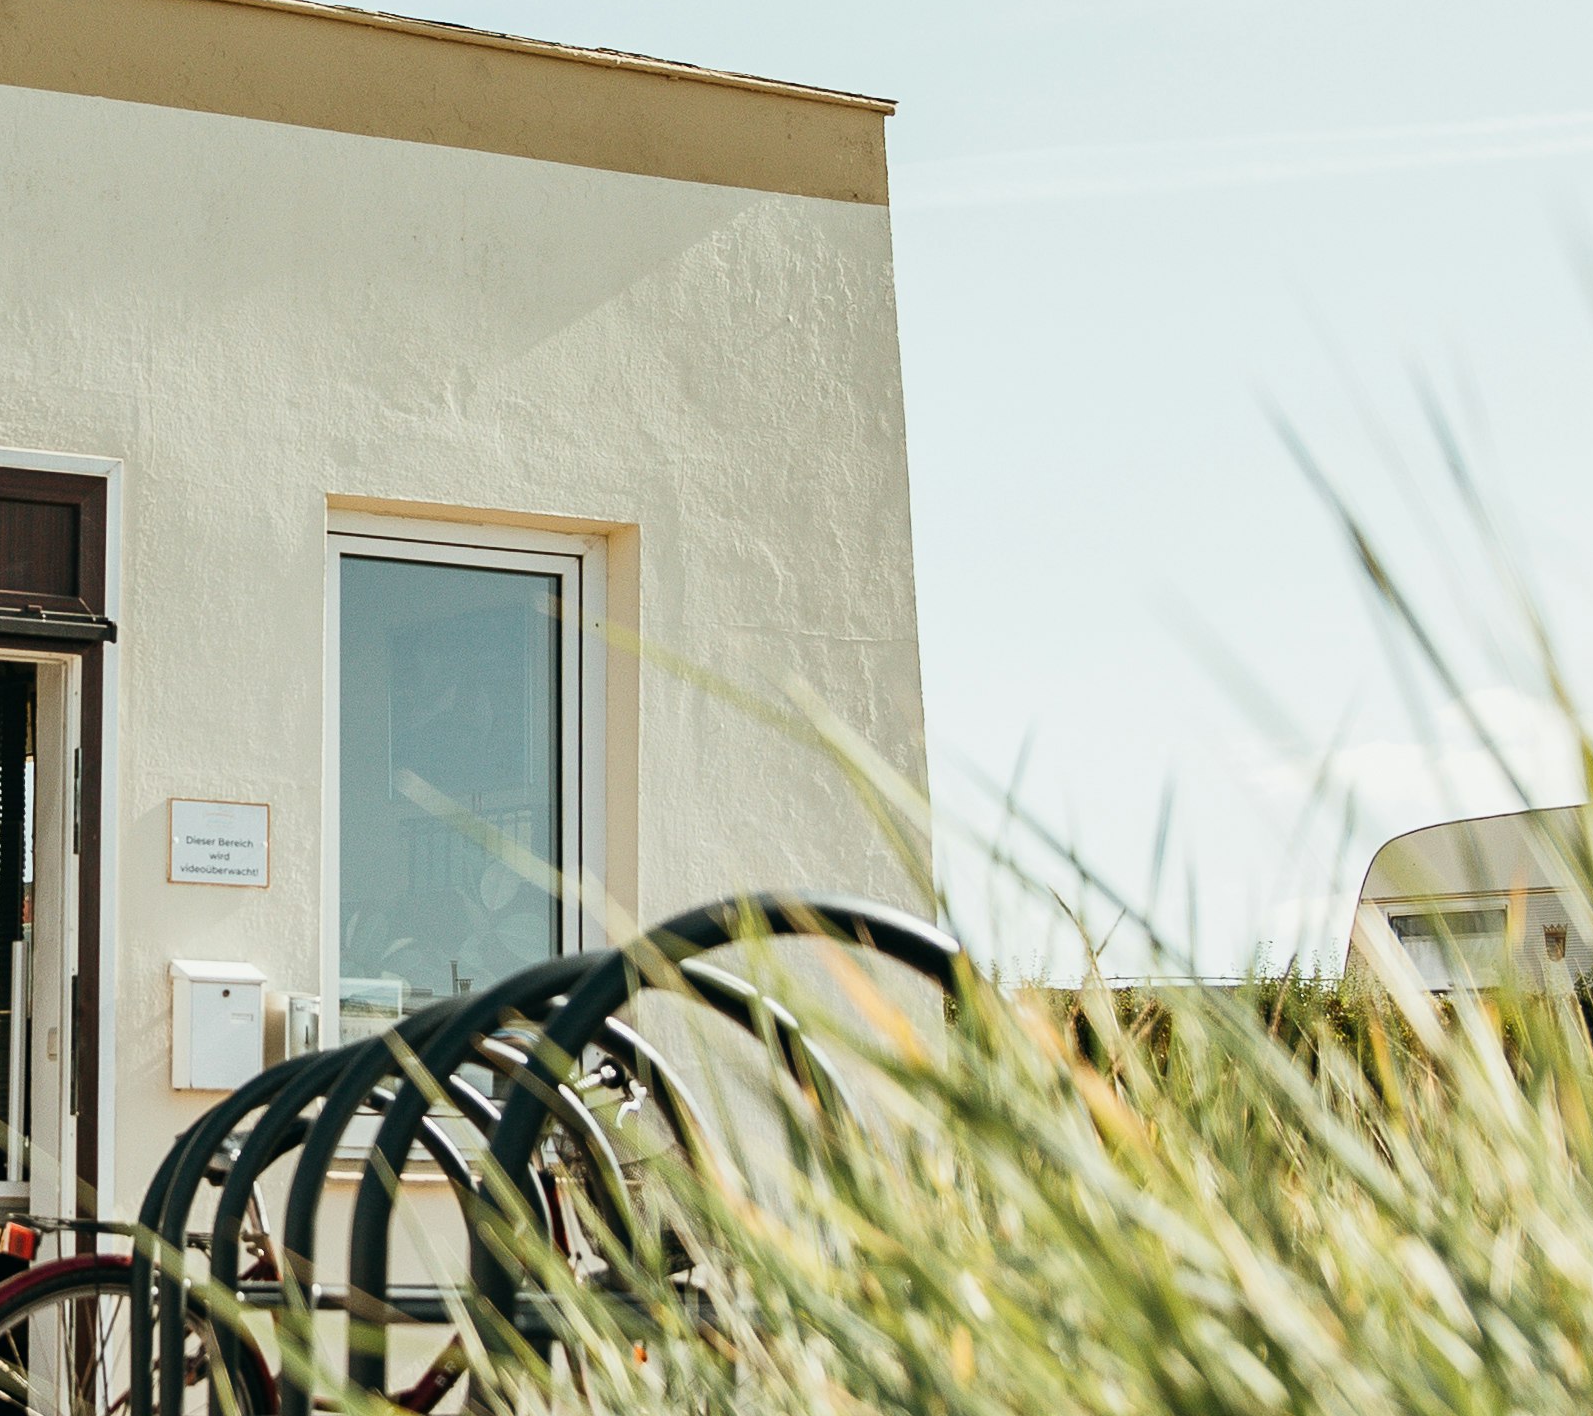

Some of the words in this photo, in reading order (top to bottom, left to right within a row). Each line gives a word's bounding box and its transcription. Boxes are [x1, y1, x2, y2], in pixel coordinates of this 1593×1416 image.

[186, 836, 215, 846] Dieser
[218, 837, 254, 848] Bereich
[209, 852, 230, 861] wird
